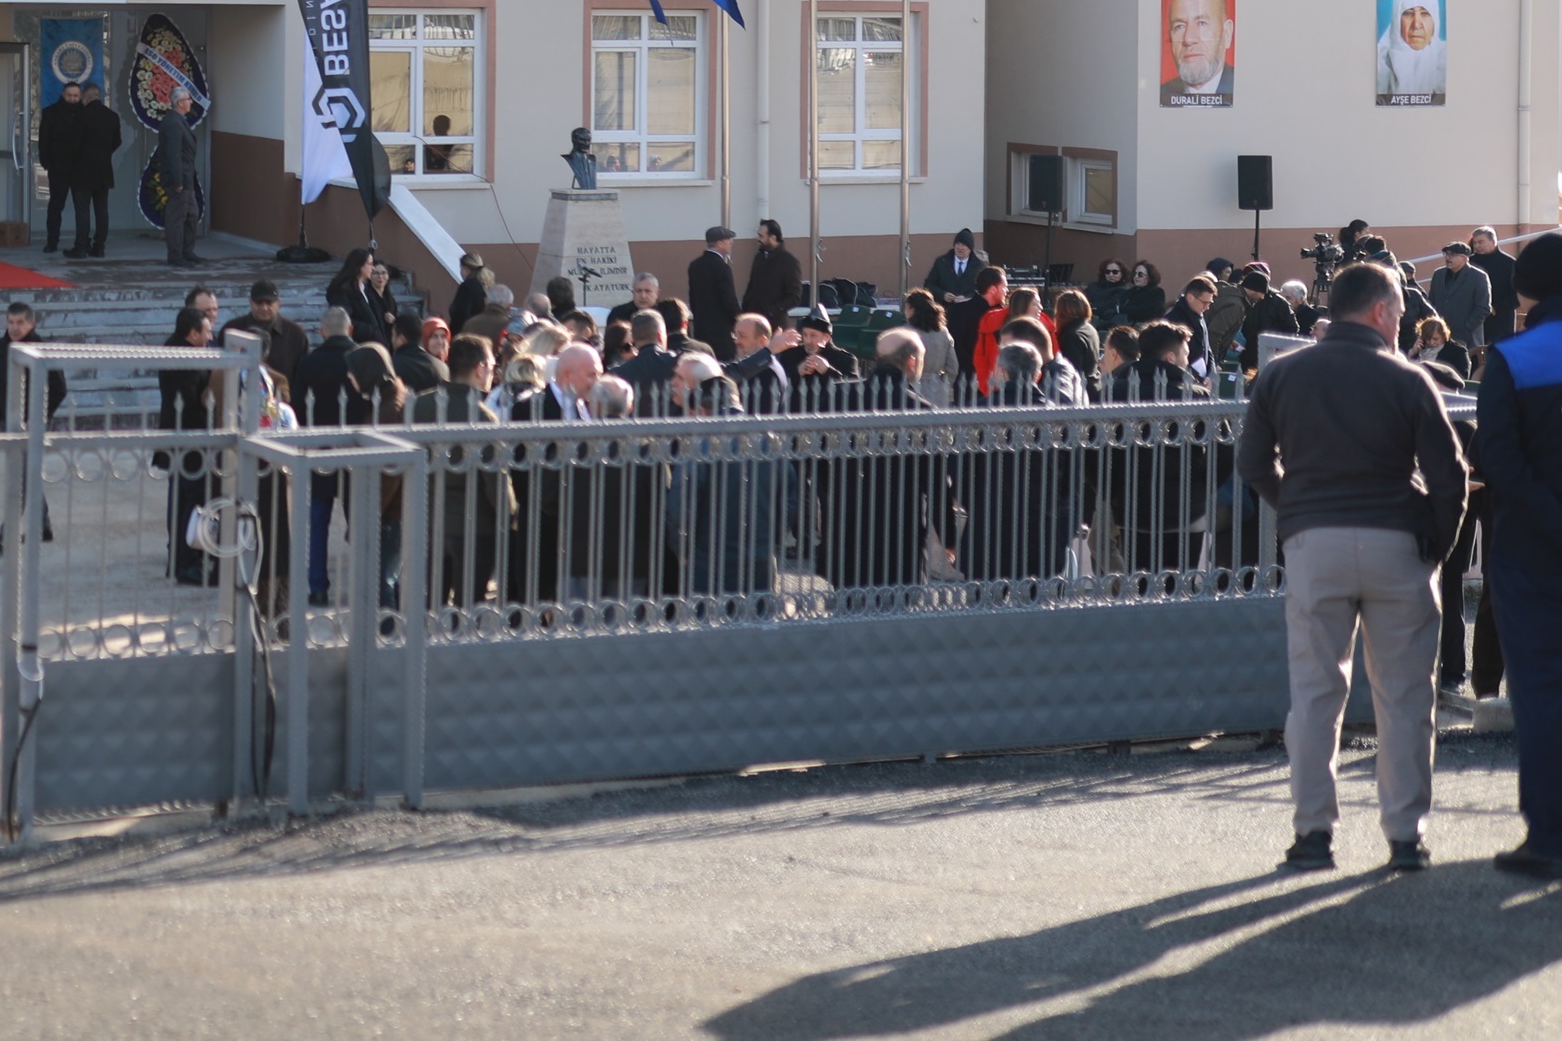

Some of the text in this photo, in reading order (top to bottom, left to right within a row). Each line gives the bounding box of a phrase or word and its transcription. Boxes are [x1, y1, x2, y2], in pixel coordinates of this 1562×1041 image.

[1171, 95, 1223, 106] DURALİ BEZCİ
[1391, 93, 1432, 106] AYŞE BEZCİ
[577, 246, 616, 255] HAYATTA
